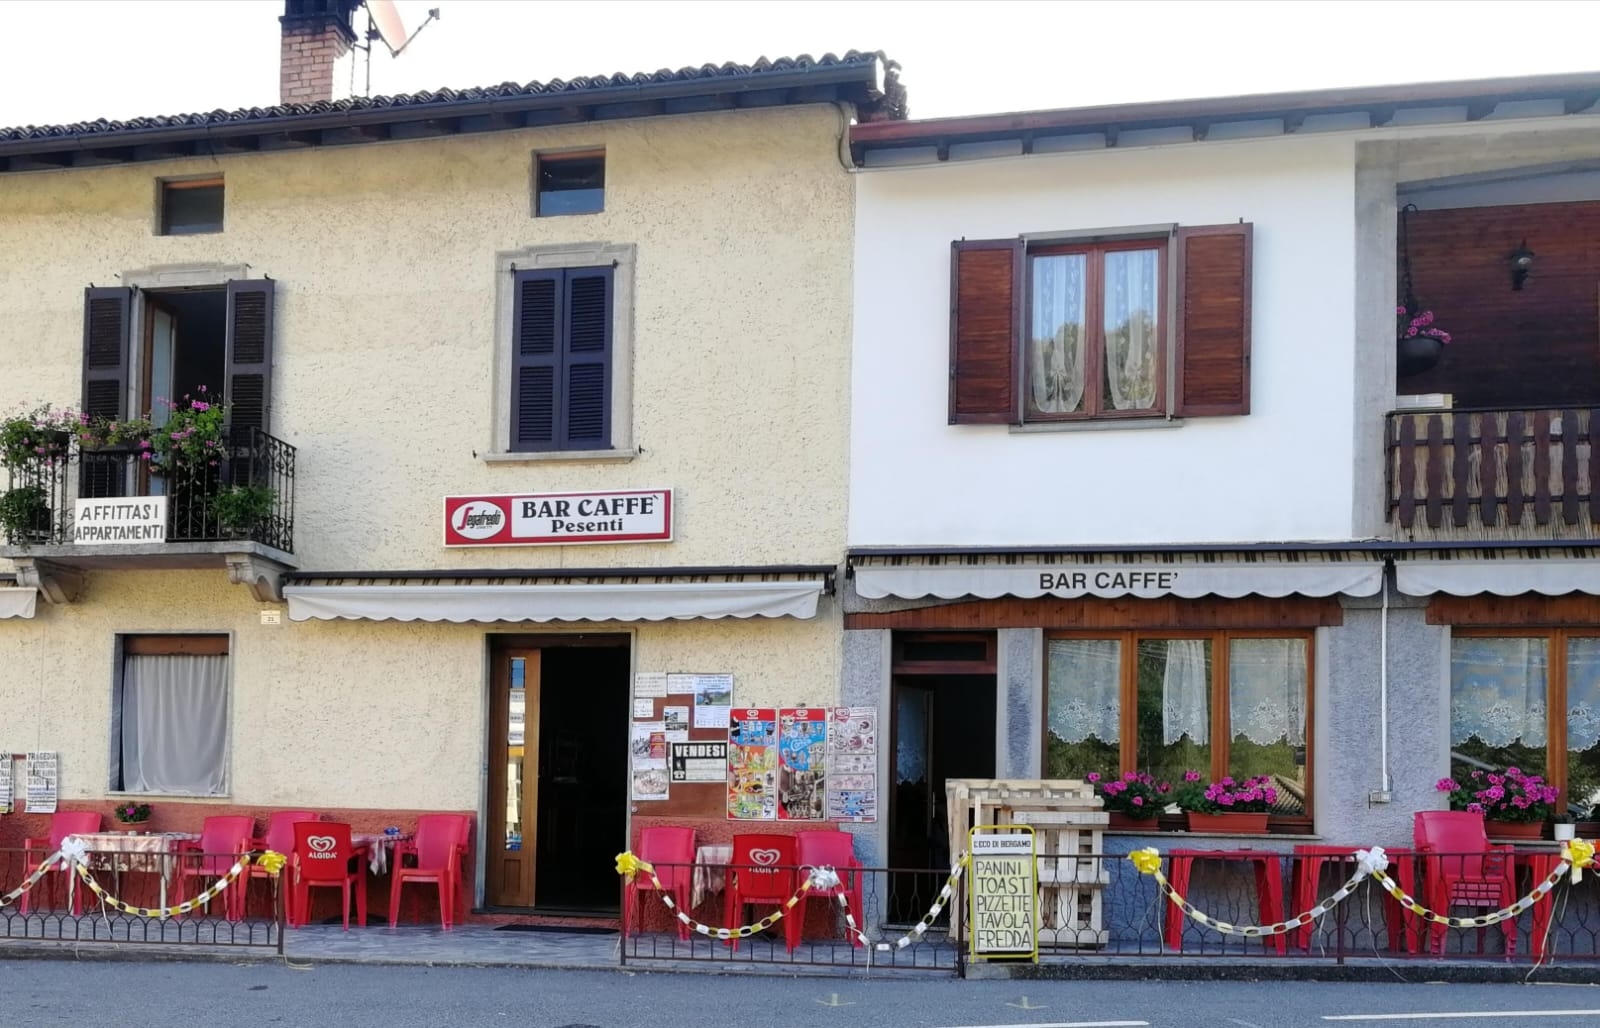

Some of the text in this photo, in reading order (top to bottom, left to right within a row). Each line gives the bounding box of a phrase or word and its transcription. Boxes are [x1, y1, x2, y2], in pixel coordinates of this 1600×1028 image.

[80, 504, 158, 521] AFFITTASI
[457, 506, 501, 530] Segafredo
[522, 500, 570, 519] BAR
[75, 524, 164, 541] APPARTAMENTI
[551, 518, 623, 533] Pesenti
[1039, 572, 1087, 590] BAR
[674, 744, 725, 758] VENDESI
[992, 840, 999, 848] DI
[1000, 840, 1031, 848] BERGAMO
[308, 851, 337, 859] ALGIDA
[976, 861, 1021, 876] PANINI
[977, 877, 1029, 894] TOAST
[977, 895, 1031, 912] PIZZETTE
[977, 912, 1031, 929] TAVOLA
[977, 930, 1032, 948] FREDDA
